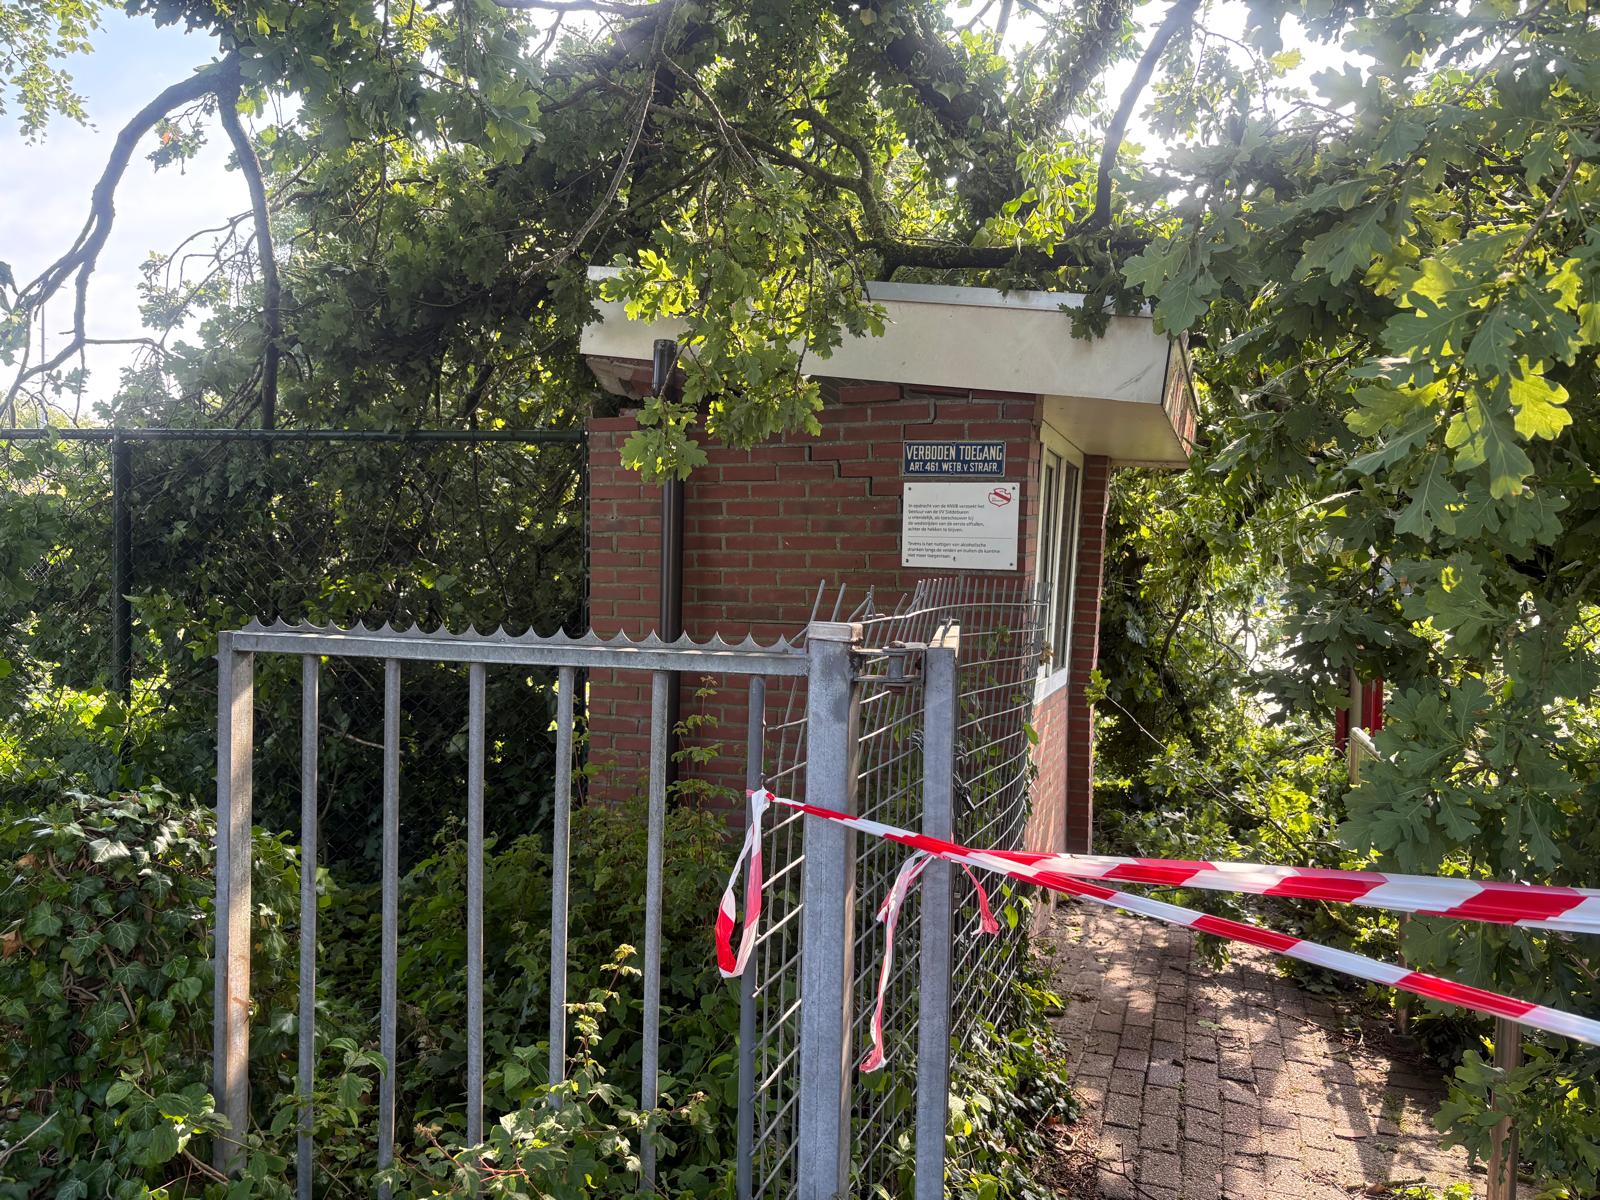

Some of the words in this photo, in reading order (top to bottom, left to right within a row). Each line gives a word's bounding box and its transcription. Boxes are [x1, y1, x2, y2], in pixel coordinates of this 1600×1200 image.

[906, 445, 956, 460] VERBODEN
[959, 445, 1002, 461] TOEGANG
[969, 462, 1000, 473] STRAFR.
